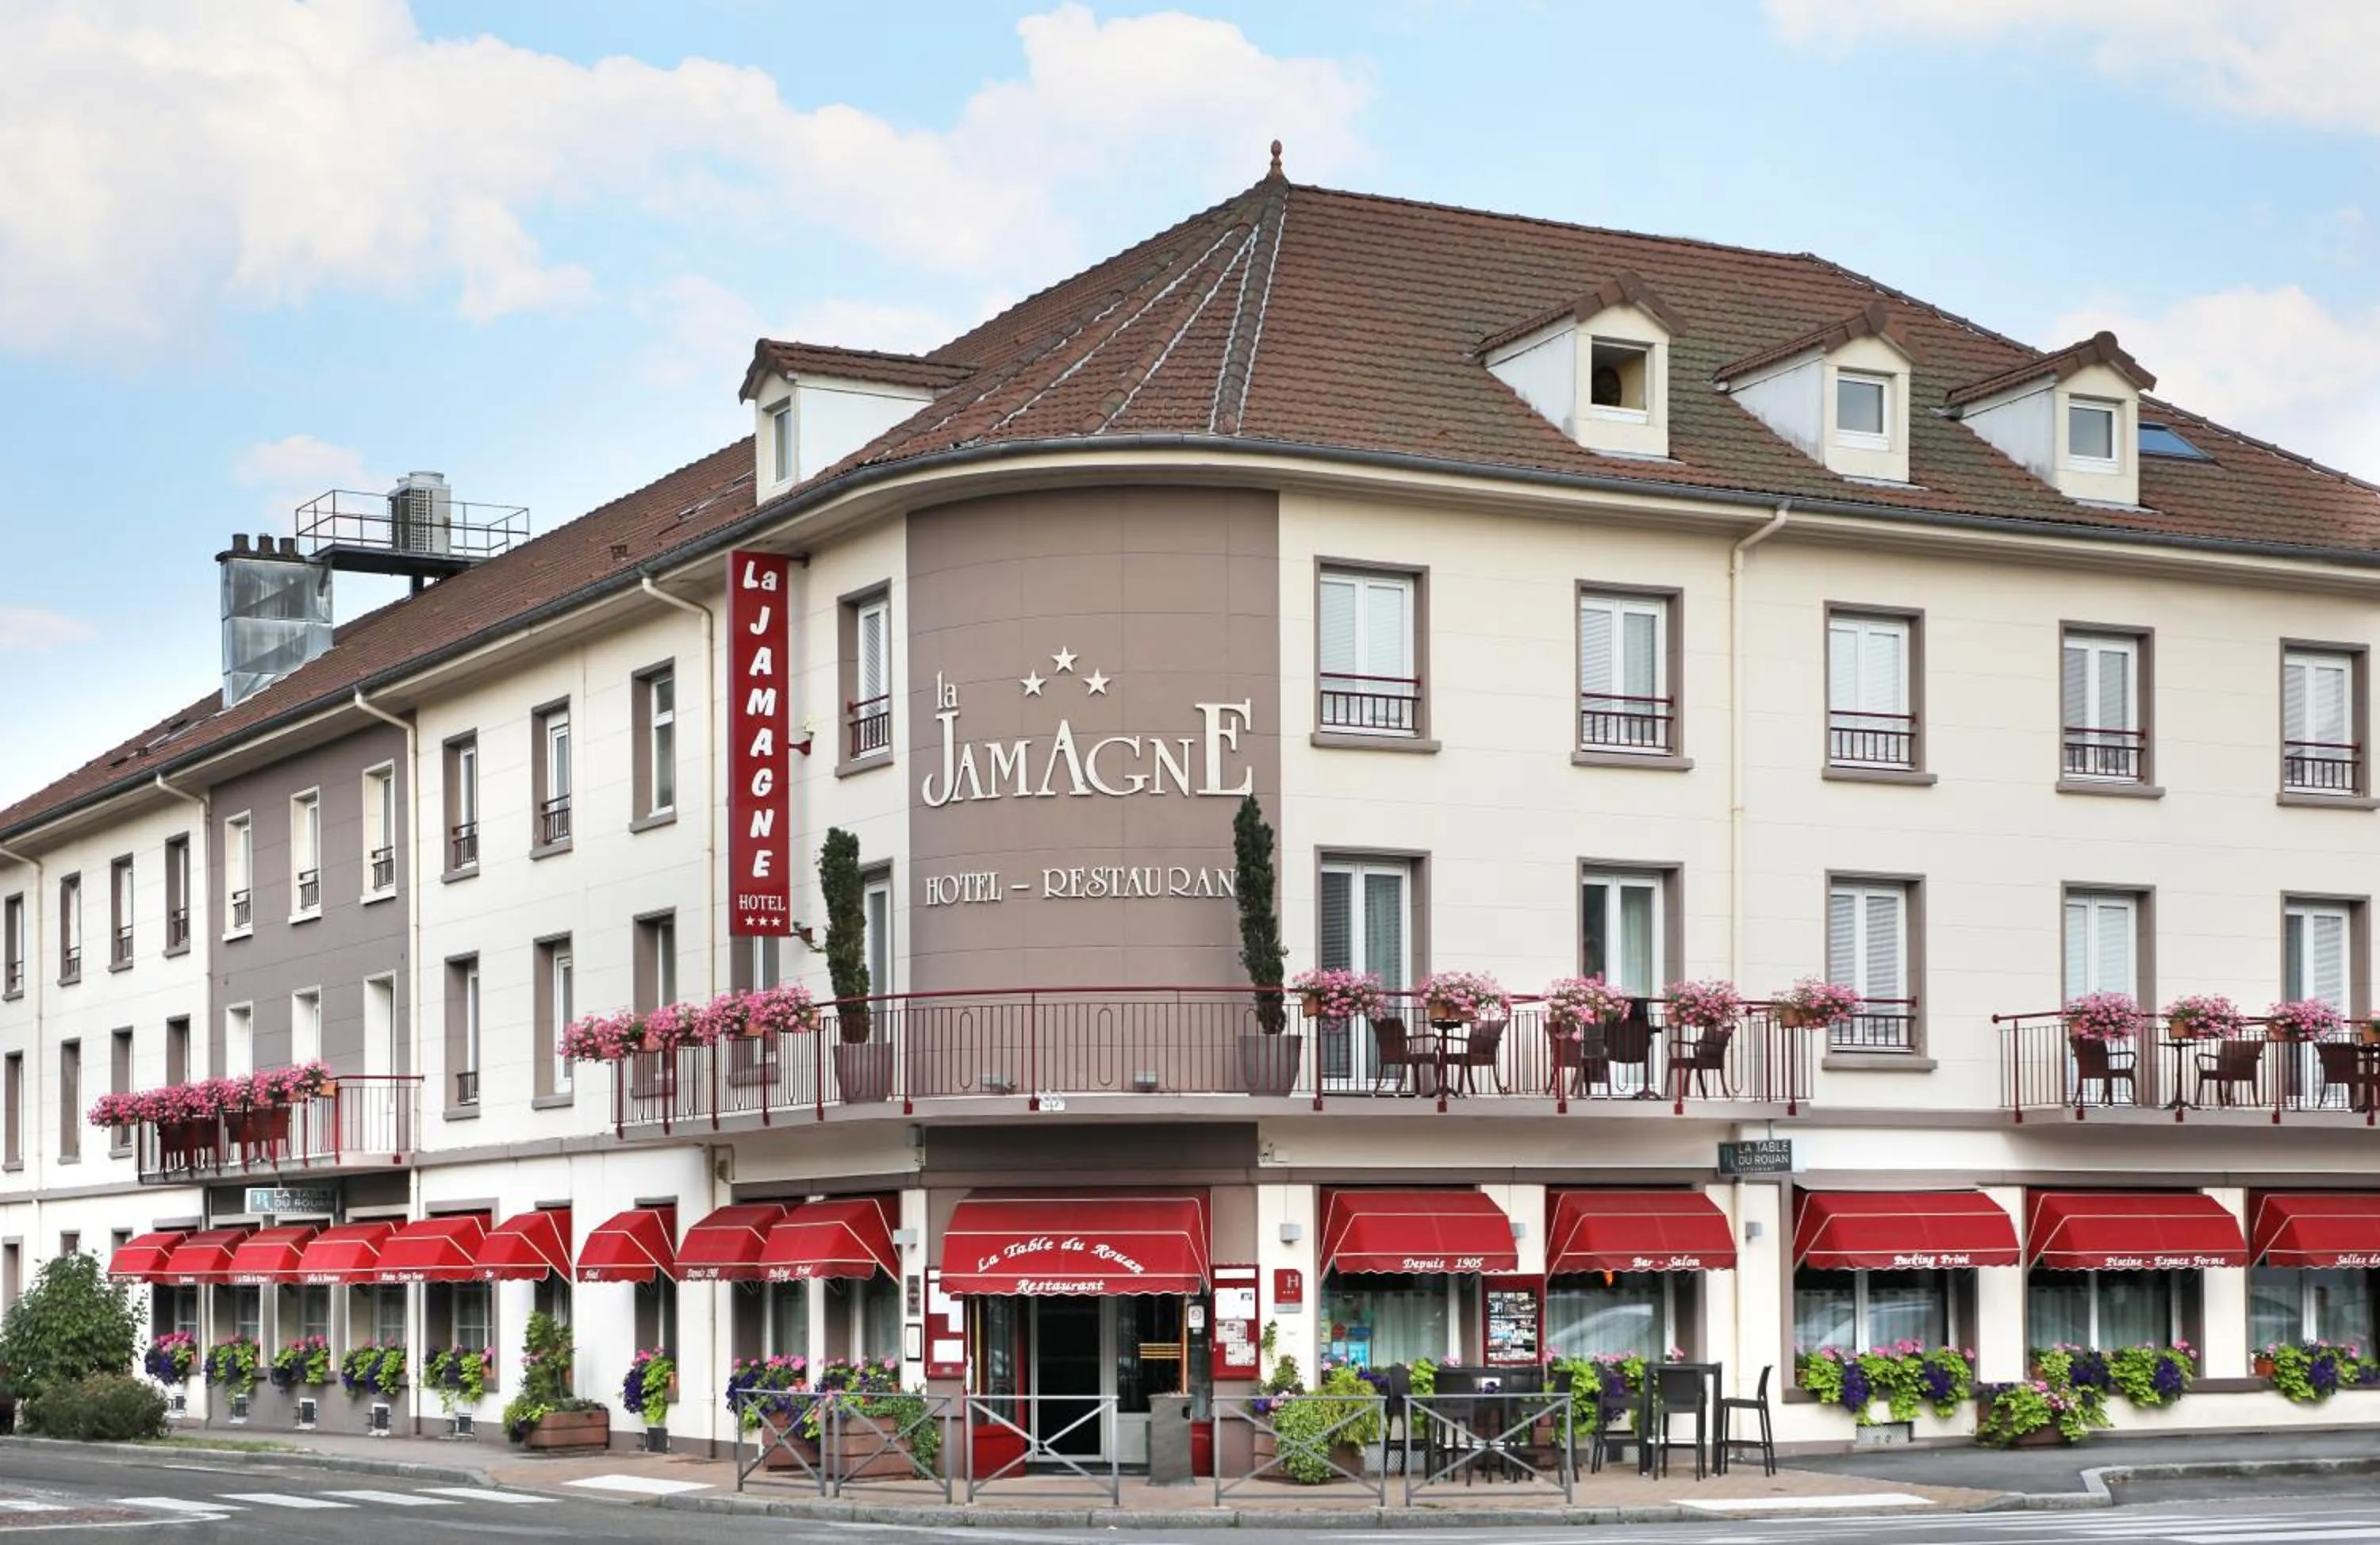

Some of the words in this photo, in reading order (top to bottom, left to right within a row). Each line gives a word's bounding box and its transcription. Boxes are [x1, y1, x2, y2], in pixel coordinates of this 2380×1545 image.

[743, 560, 778, 591] La
[937, 671, 958, 710] la
[746, 605, 777, 878] JAMAGNE
[922, 698, 1252, 807] JAMAGNE
[926, 872, 1003, 906] HOTEL
[1042, 866, 1239, 899] RESTAURAN
[739, 894, 786, 911] HOTEL
[1738, 1142, 1752, 1154] LA
[1755, 1141, 1789, 1152] TABLE
[1738, 1156, 1752, 1165] DU
[1754, 1154, 1789, 1165] ROUAN
[977, 1253, 1000, 1273] La
[1004, 1236, 1054, 1259] Table
[1061, 1236, 1085, 1251] du
[1632, 1256, 1653, 1267] Bar
[1668, 1254, 1701, 1267] Salon
[1894, 1253, 1936, 1268] Parking
[2106, 1256, 2142, 1267] Piscine
[2153, 1256, 2190, 1268] Espace
[1402, 1257, 1445, 1271] Depuis
[1454, 1257, 1484, 1268] 1905
[1016, 1279, 1104, 1293] Restaurant
[1287, 1275, 1299, 1288] H
